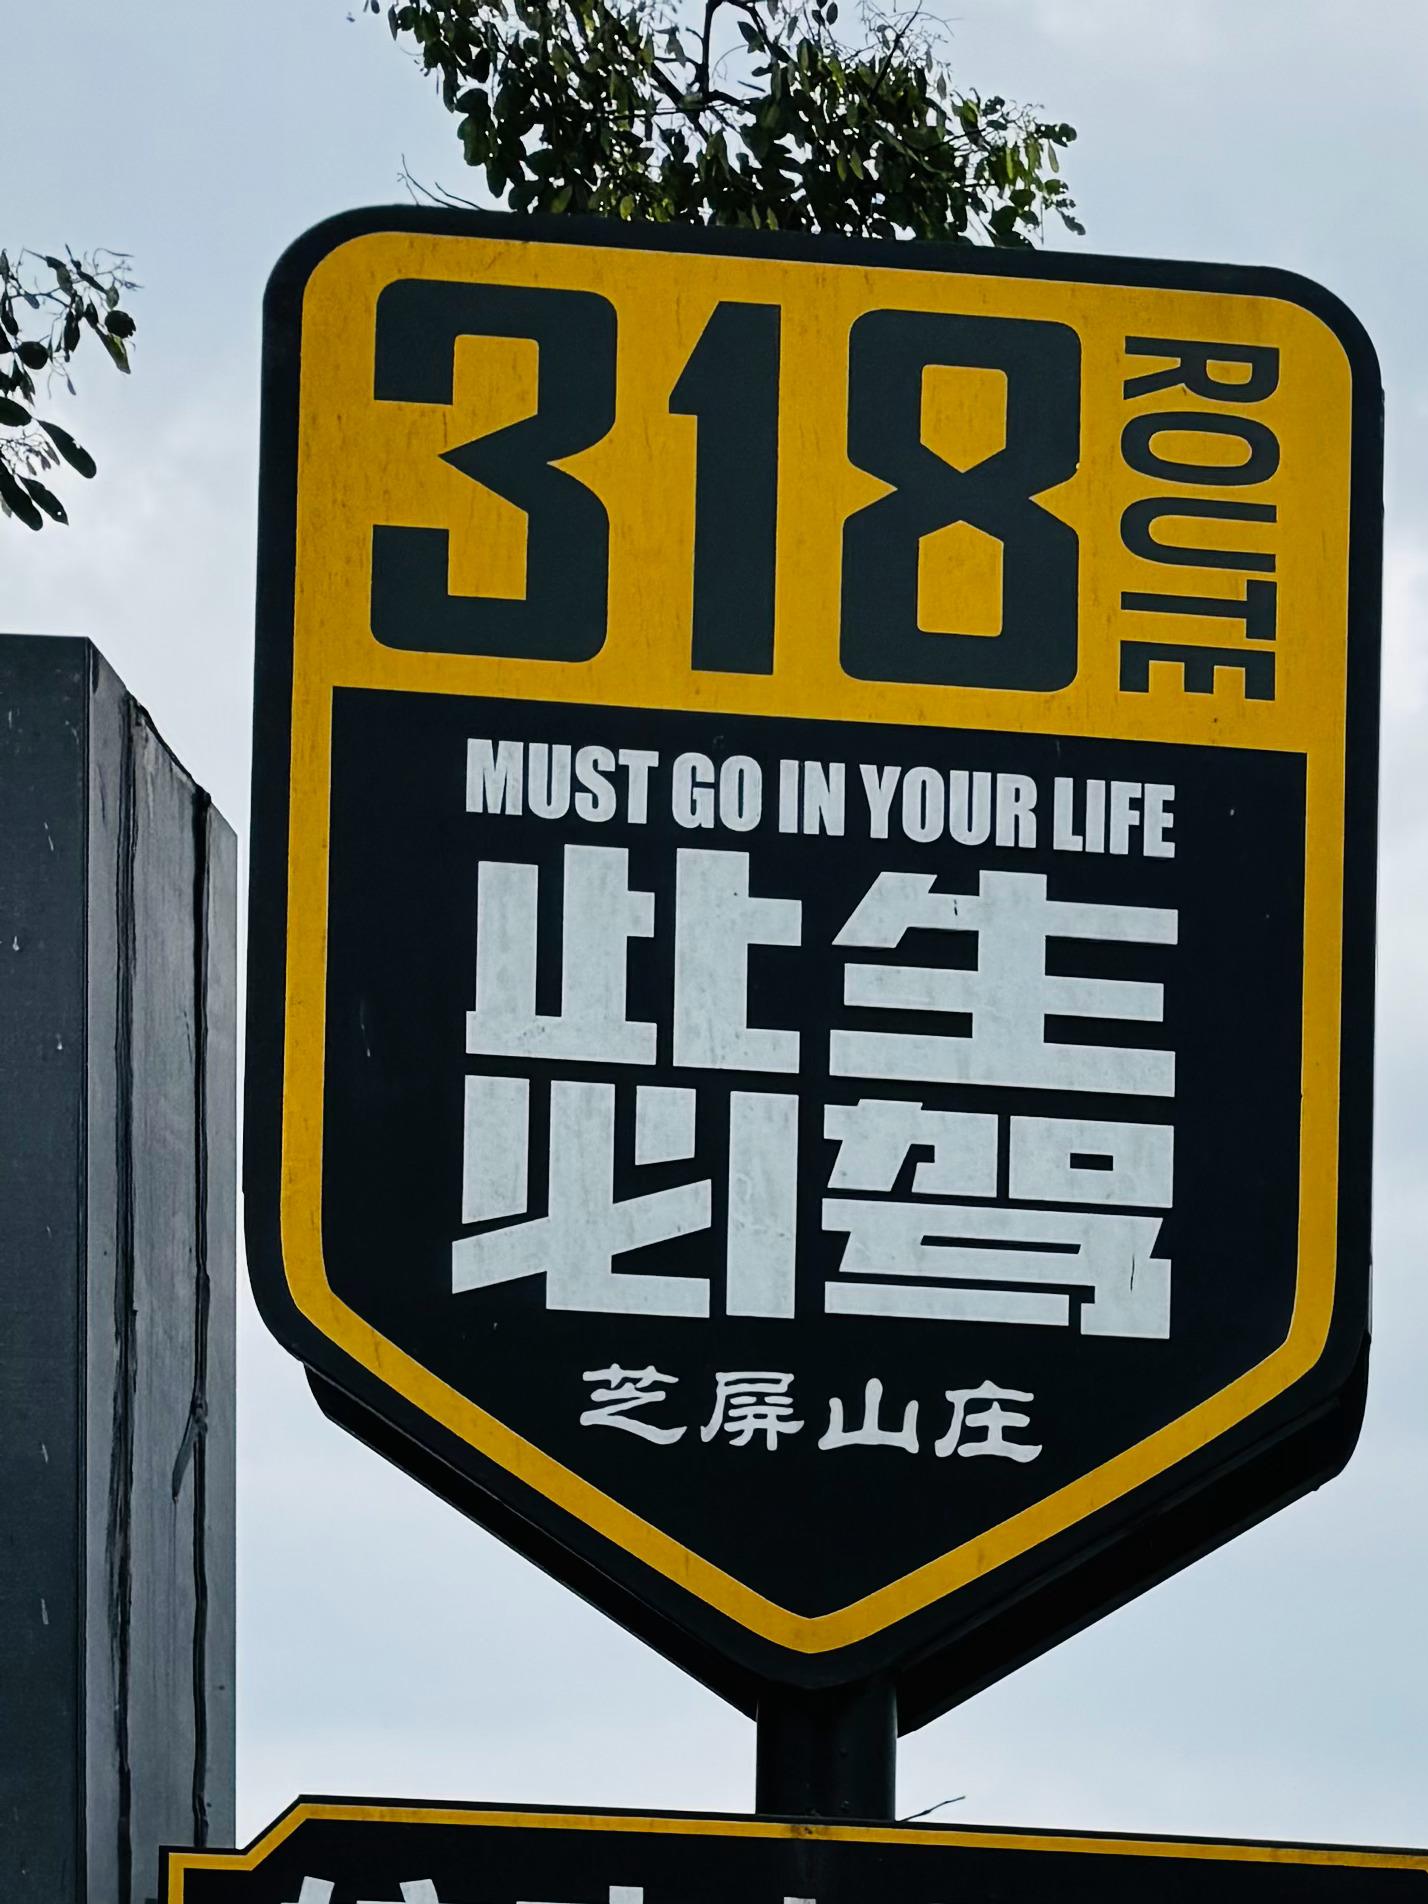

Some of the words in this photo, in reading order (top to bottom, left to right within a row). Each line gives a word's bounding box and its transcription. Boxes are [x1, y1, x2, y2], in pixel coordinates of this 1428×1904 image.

[371, 277, 1083, 694] 318
[1120, 336, 1281, 702] ROUTE
[466, 738, 659, 825] MUST
[672, 753, 762, 832] GO
[779, 760, 845, 837] IN
[860, 764, 1038, 849] YOUR
[1054, 777, 1176, 858] LIFE
[465, 843, 1179, 1098] 此生
[452, 1075, 1176, 1340] 必驾
[580, 1364, 1043, 1463] 芝屏山庄
